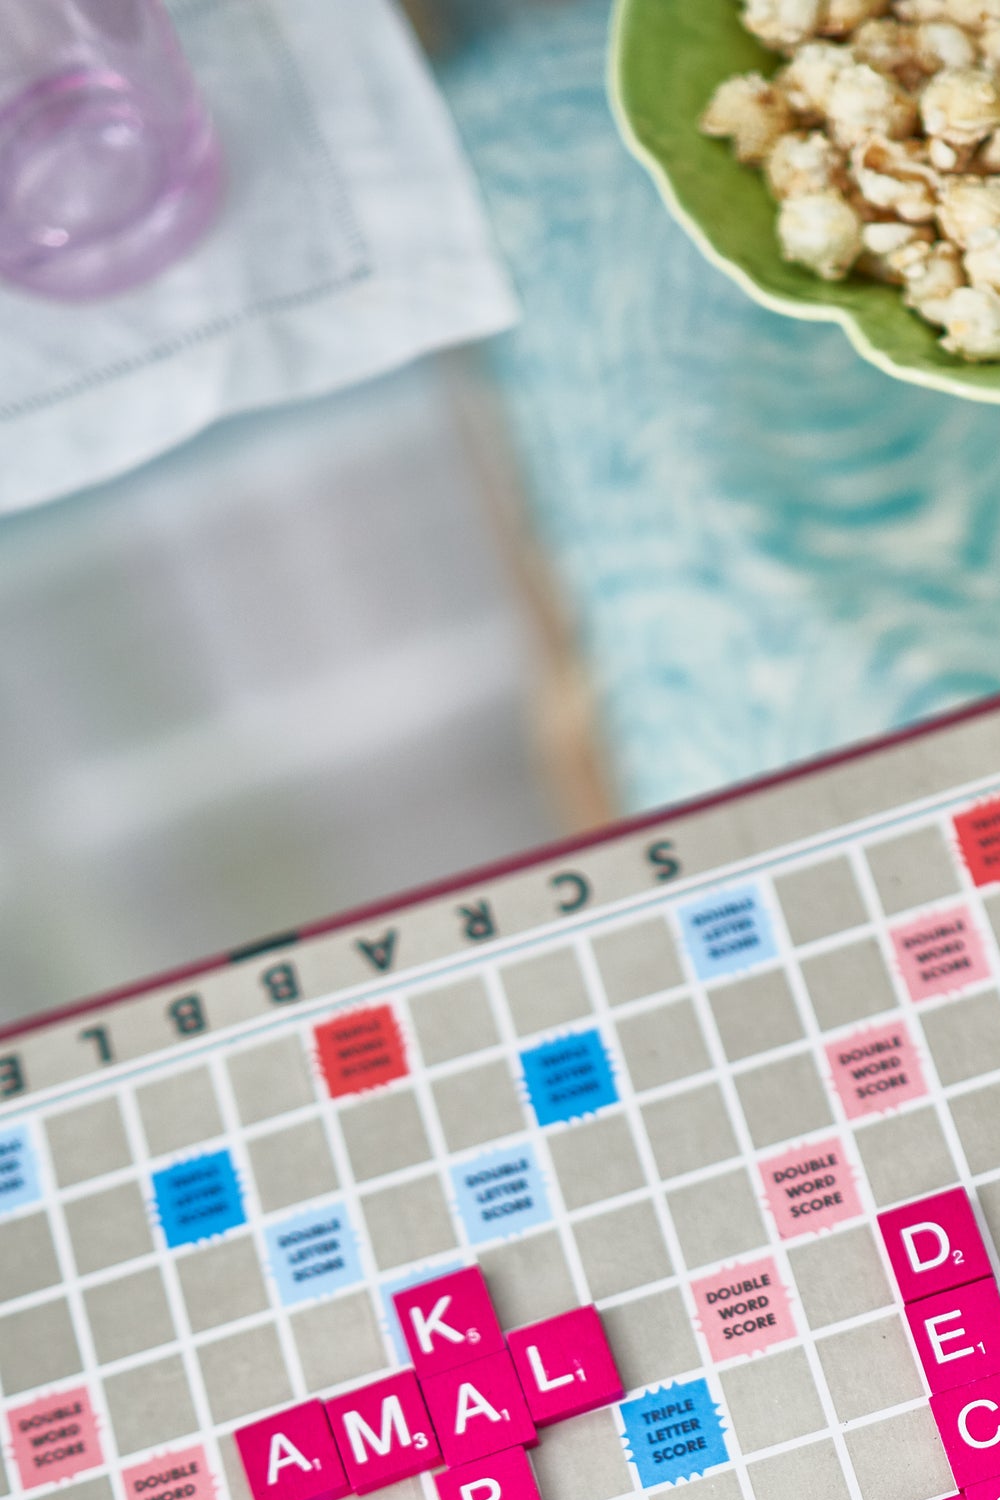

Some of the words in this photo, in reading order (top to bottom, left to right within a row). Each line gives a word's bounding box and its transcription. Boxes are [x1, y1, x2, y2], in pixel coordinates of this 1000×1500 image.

[903, 921, 964, 949] DOUBLE
[915, 941, 964, 964] WORD
[920, 957, 971, 982] SCORE
[839, 1037, 901, 1065] DOUBLE
[852, 1057, 900, 1080] WORD
[856, 1074, 907, 1098] SCORE
[466, 1160, 528, 1187] DOUBLE
[773, 1154, 836, 1183] DOUBLE
[477, 1179, 528, 1203] LETTER
[785, 1175, 835, 1198] WORD
[482, 1197, 533, 1221] SCORE
[790, 1192, 842, 1218] SCORE
[279, 1220, 340, 1248] DOUBLE
[290, 1240, 339, 1264] LETTER
[293, 1258, 344, 1282] SCORE
[706, 1274, 770, 1304] DOUBLE
[718, 1296, 768, 1320] WORD
[723, 1313, 776, 1339] SCORE
[19, 1403, 82, 1432] DOUBLE
[641, 1399, 694, 1424] TRIPLE
[31, 1424, 79, 1448] WORD
[647, 1418, 701, 1444] LETTER
[34, 1442, 84, 1467] SCORE
[653, 1437, 707, 1463] SCORE
[134, 1463, 198, 1492] DOUBLE
